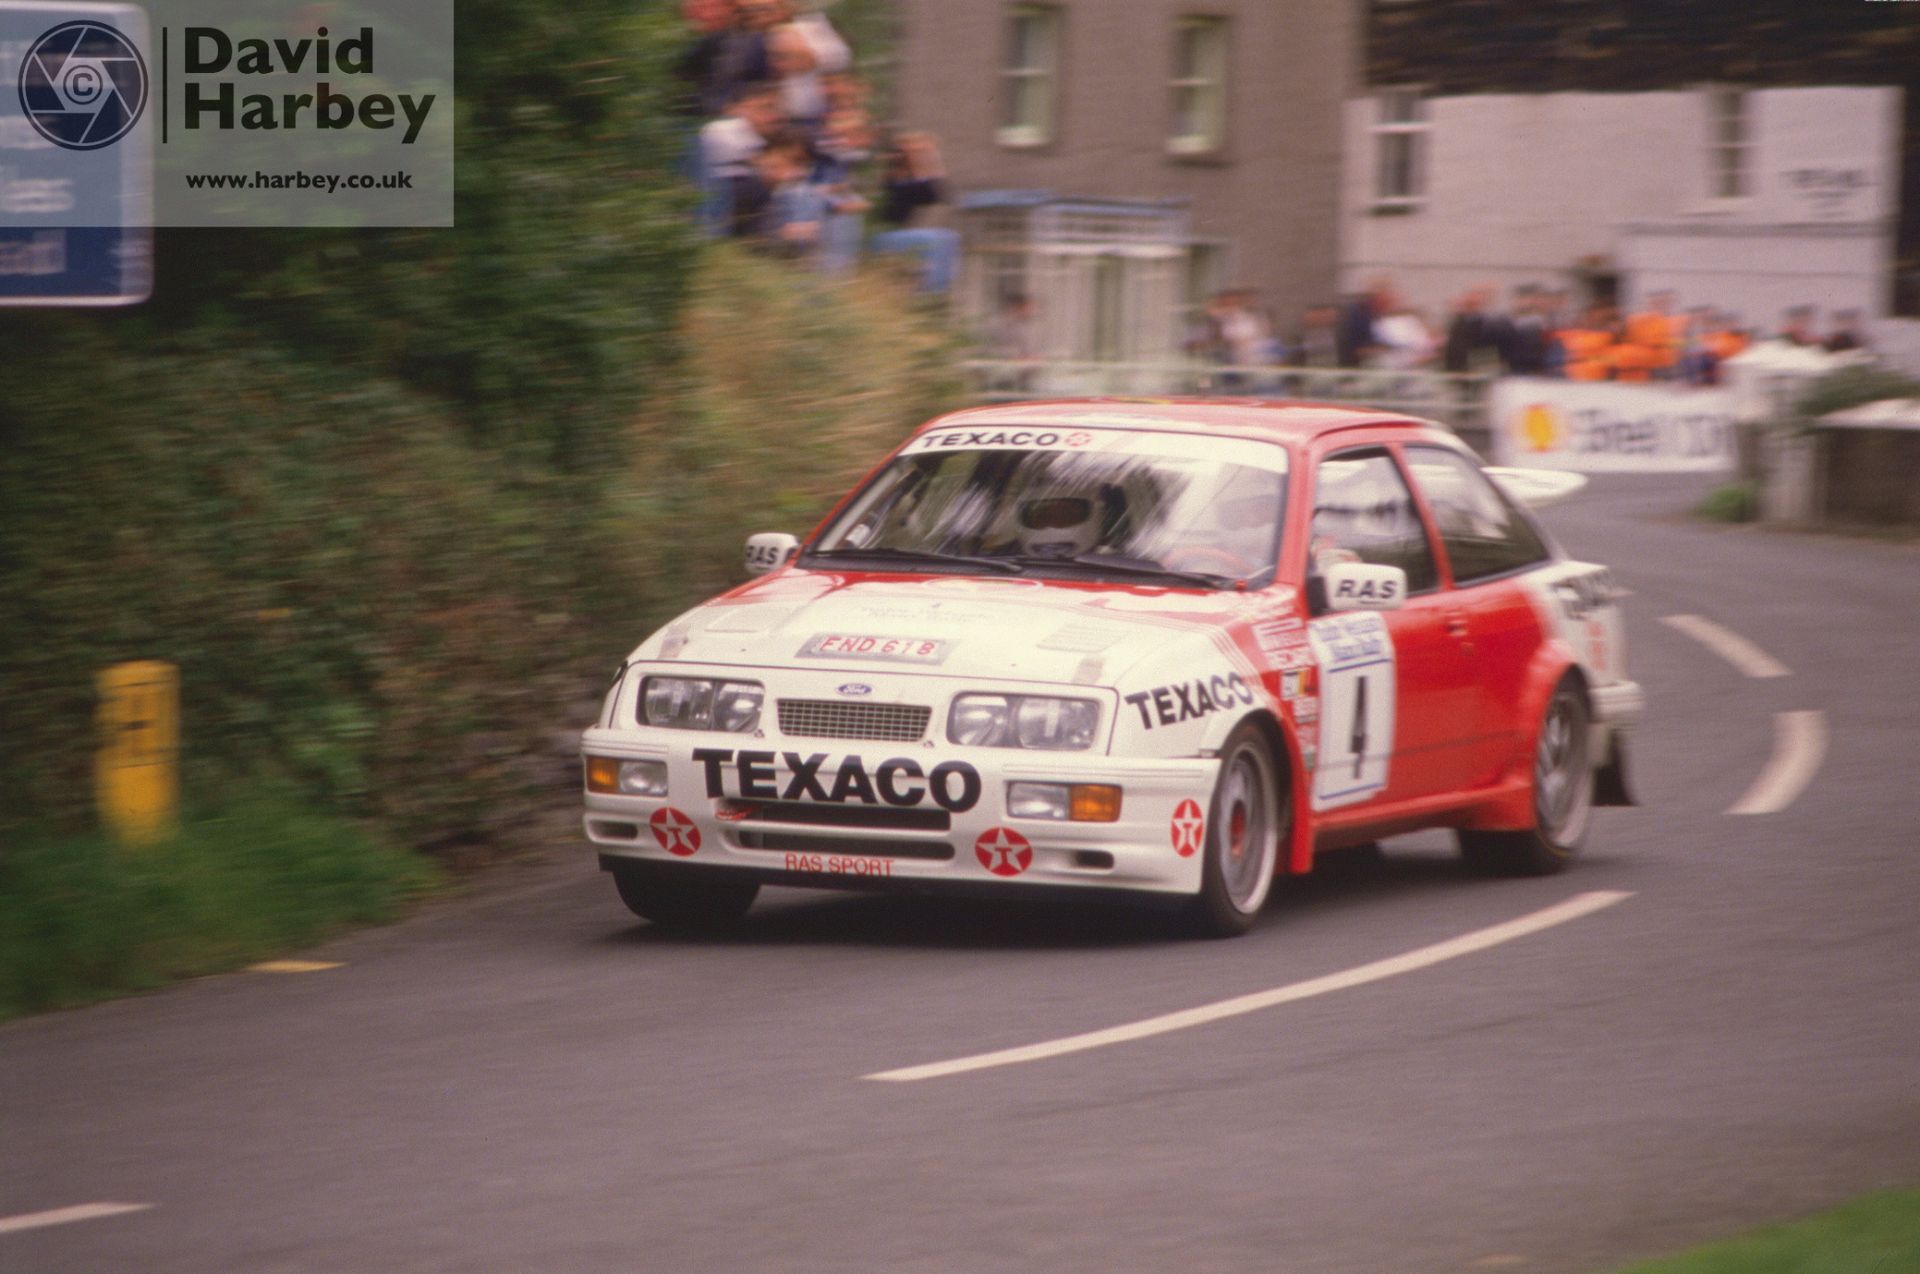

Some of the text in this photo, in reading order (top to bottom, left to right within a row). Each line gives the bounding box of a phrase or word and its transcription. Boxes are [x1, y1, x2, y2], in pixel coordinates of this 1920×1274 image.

[923, 432, 1059, 448] TEXACO
[1336, 579, 1397, 599] RAS
[880, 640, 935, 656] 618
[1124, 672, 1254, 730] TEXACO
[692, 747, 982, 812] TEXACO
[785, 852, 895, 877] RAS SPORT
